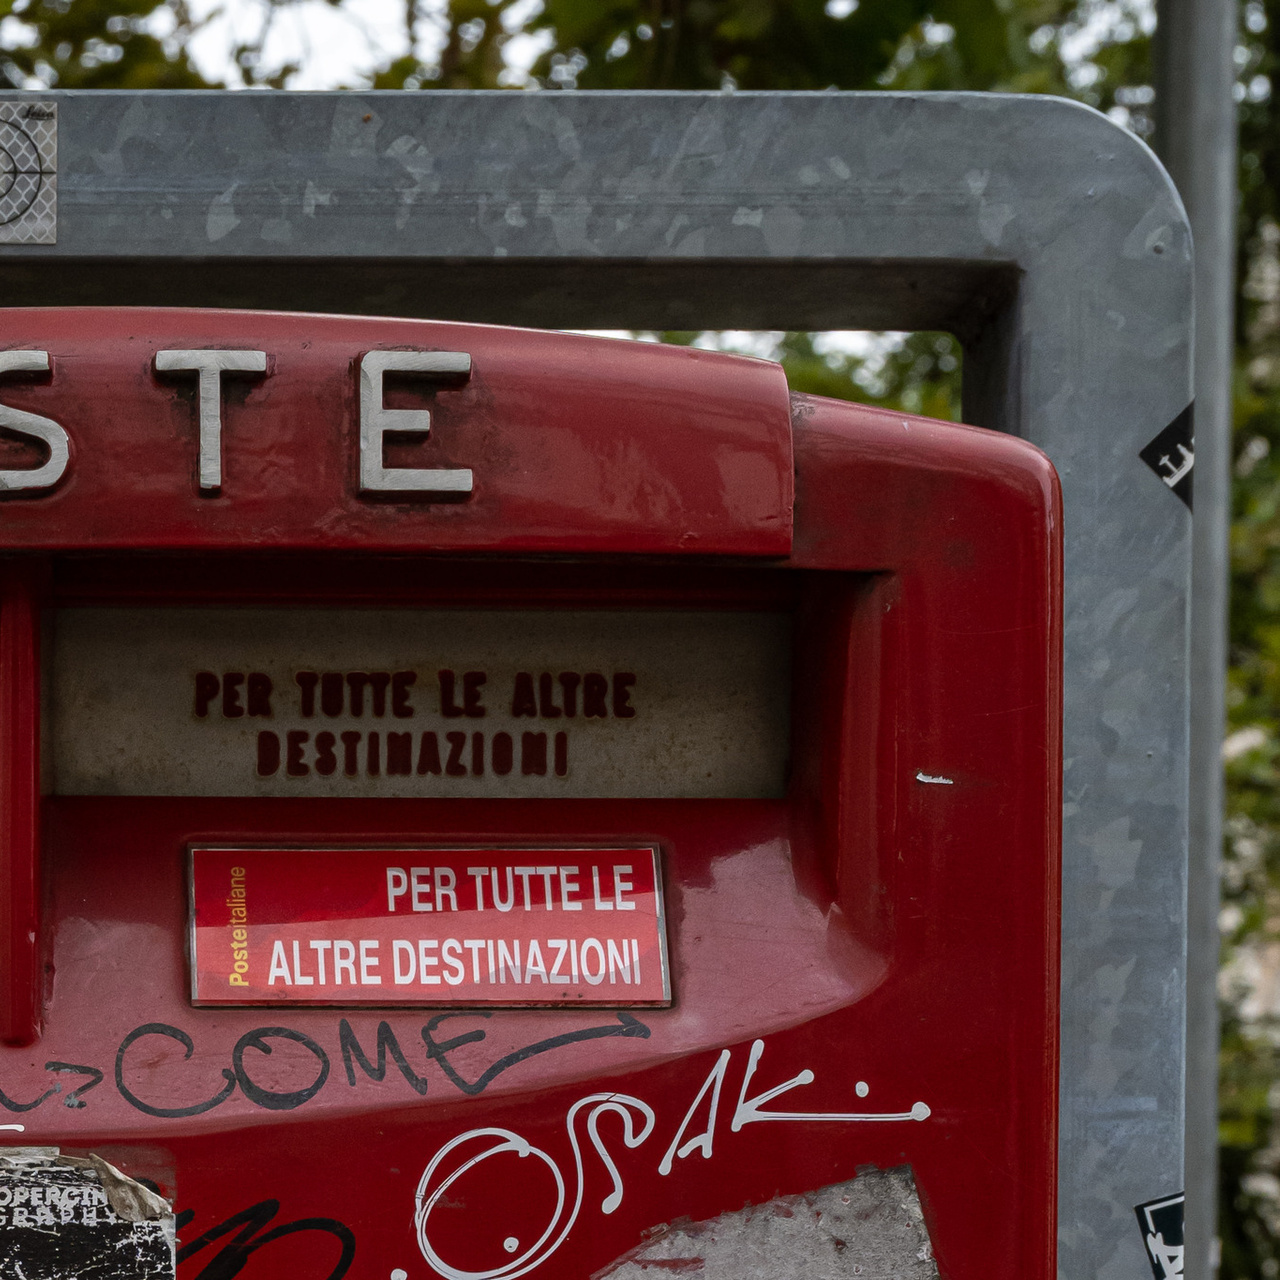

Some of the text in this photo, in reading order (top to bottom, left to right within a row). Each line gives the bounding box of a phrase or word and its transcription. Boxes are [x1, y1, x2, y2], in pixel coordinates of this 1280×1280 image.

[194, 669, 637, 718] PER TUTTE LE ALTRE
[257, 731, 568, 777] DESTINAZIONI
[386, 865, 636, 911] PER TUTTE LE
[229, 866, 247, 986] Posteitaliane
[268, 938, 641, 985] ALTRE DESTINAZIONI
[115, 1011, 520, 1117] COME
